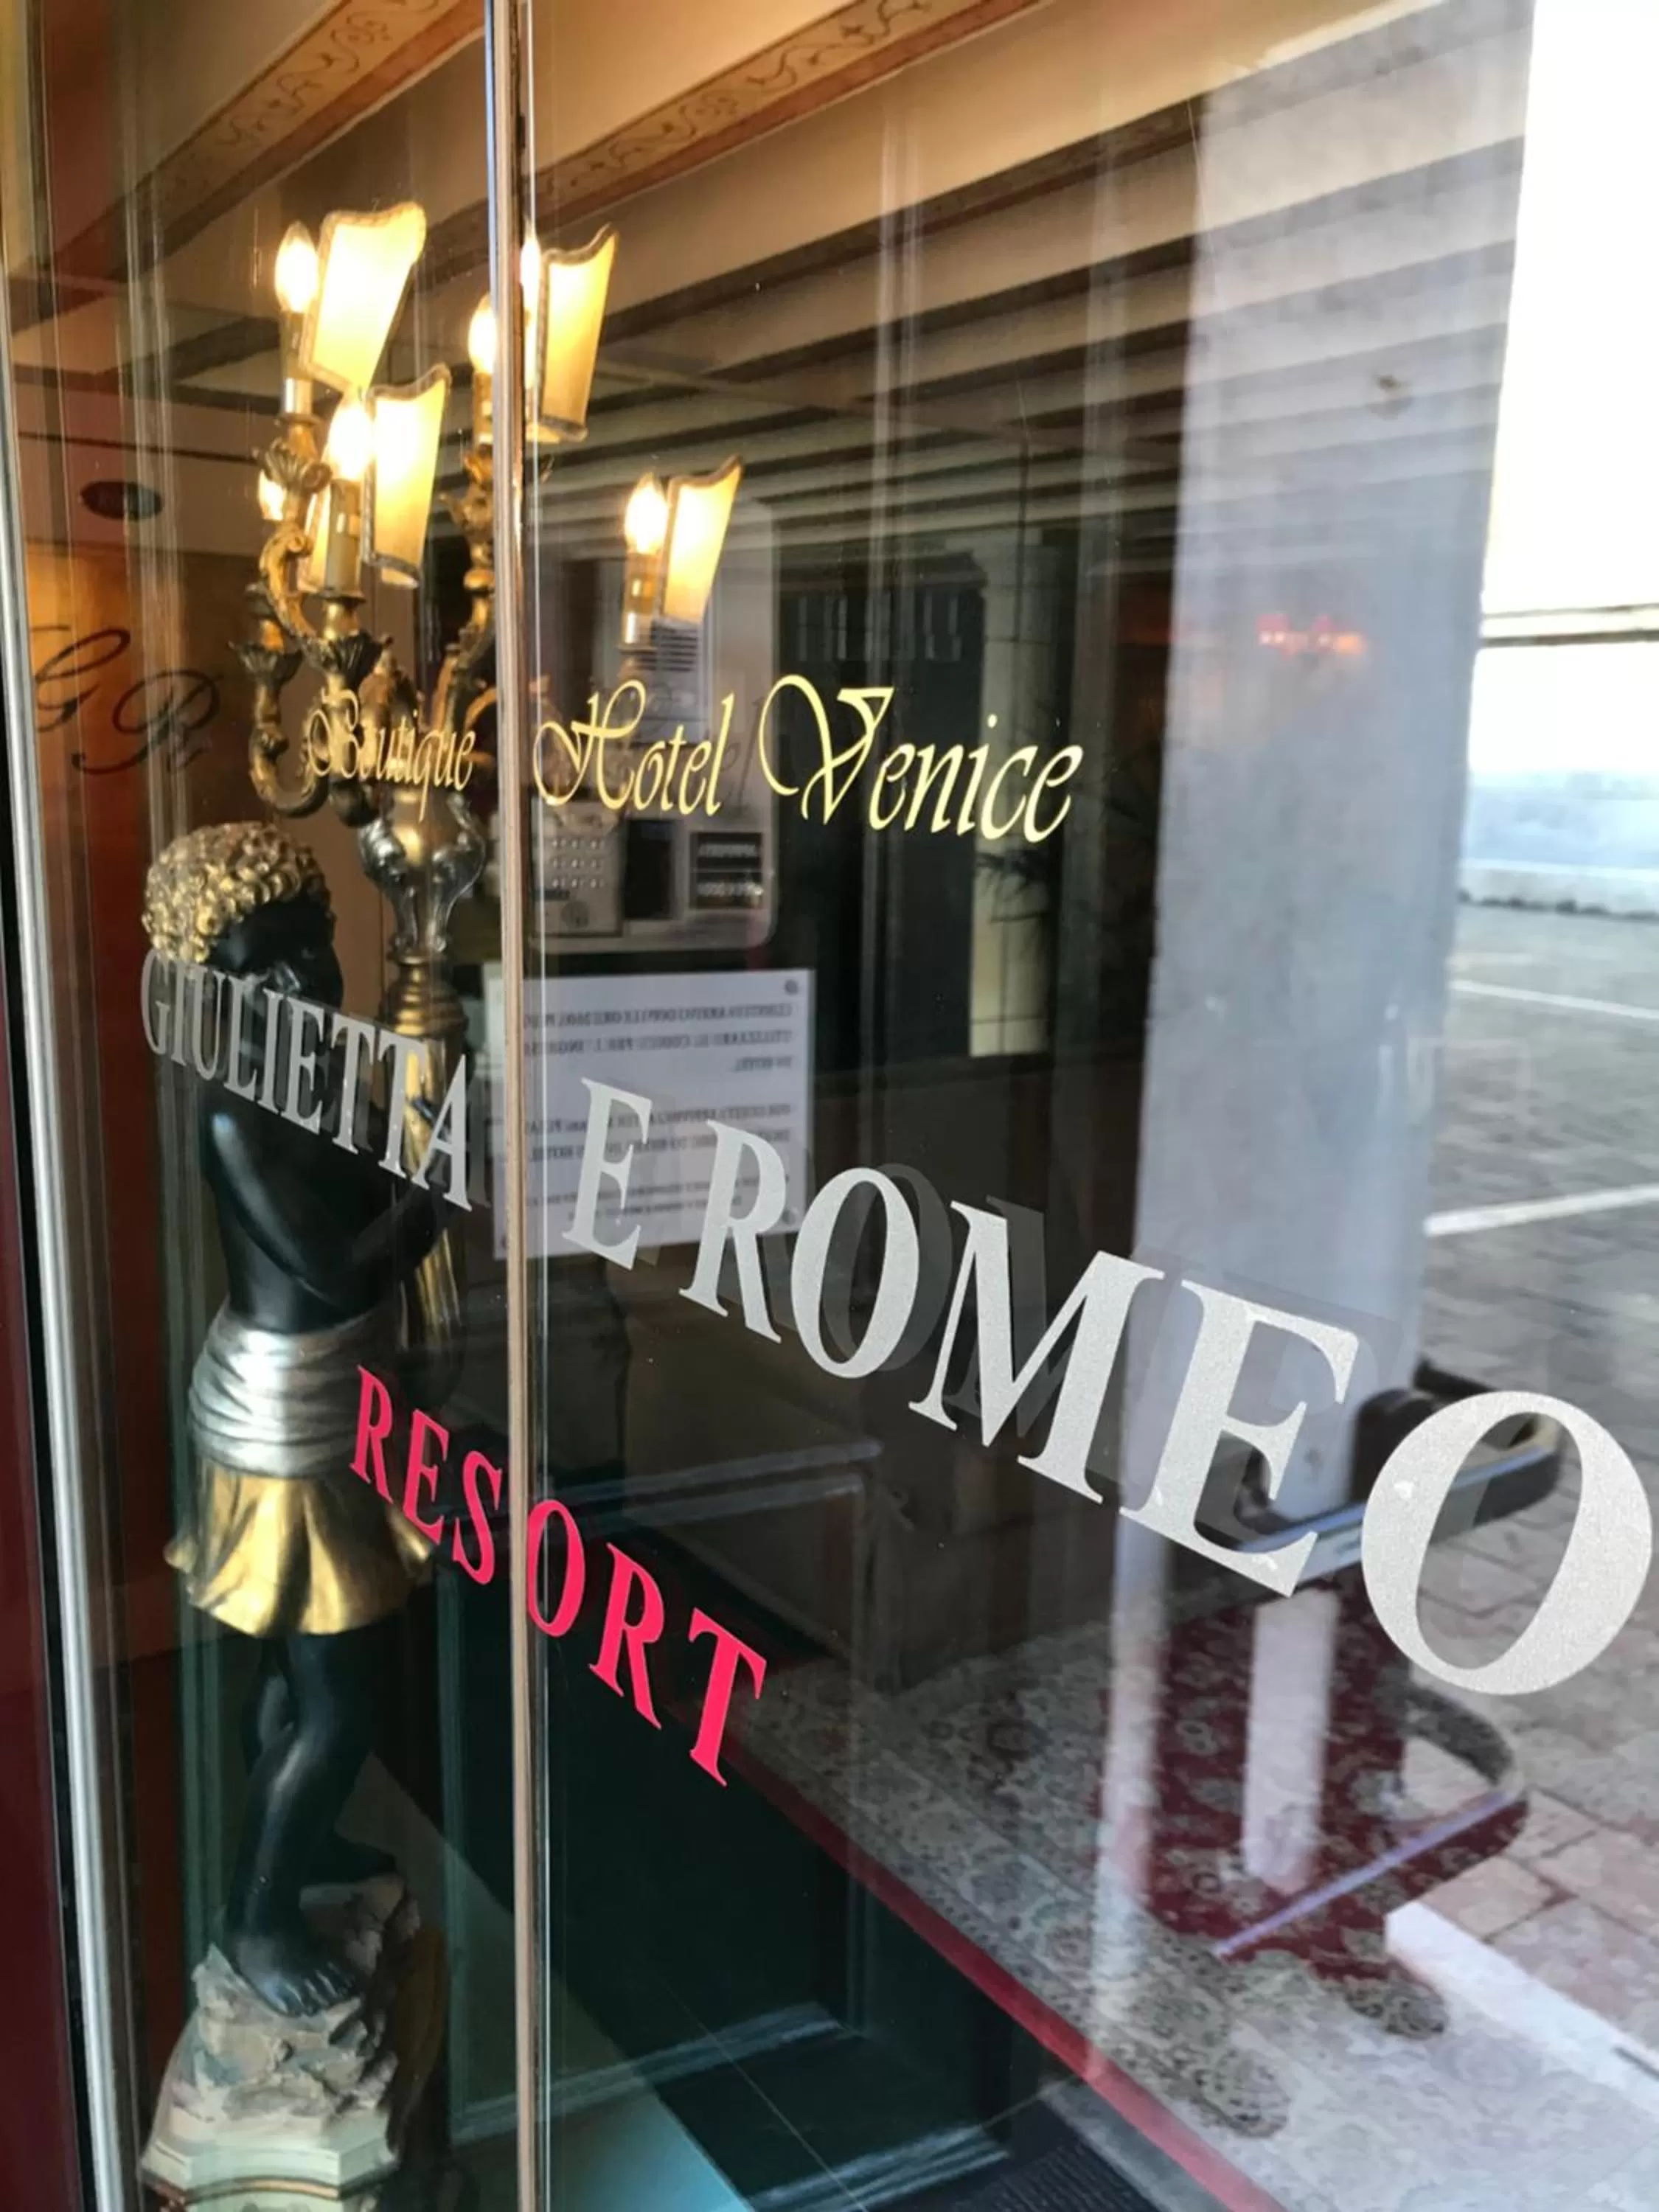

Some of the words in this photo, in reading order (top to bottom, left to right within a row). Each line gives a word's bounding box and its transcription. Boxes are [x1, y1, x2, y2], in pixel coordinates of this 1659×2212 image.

[307, 686, 476, 823] Boutique
[532, 678, 736, 817] Hotel
[758, 674, 1084, 844] Venice
[140, 948, 473, 1212] GIULIETTA
[561, 1077, 653, 1270] E
[678, 1119, 1653, 1697] ROMEO
[349, 1364, 768, 1787] RESORT
